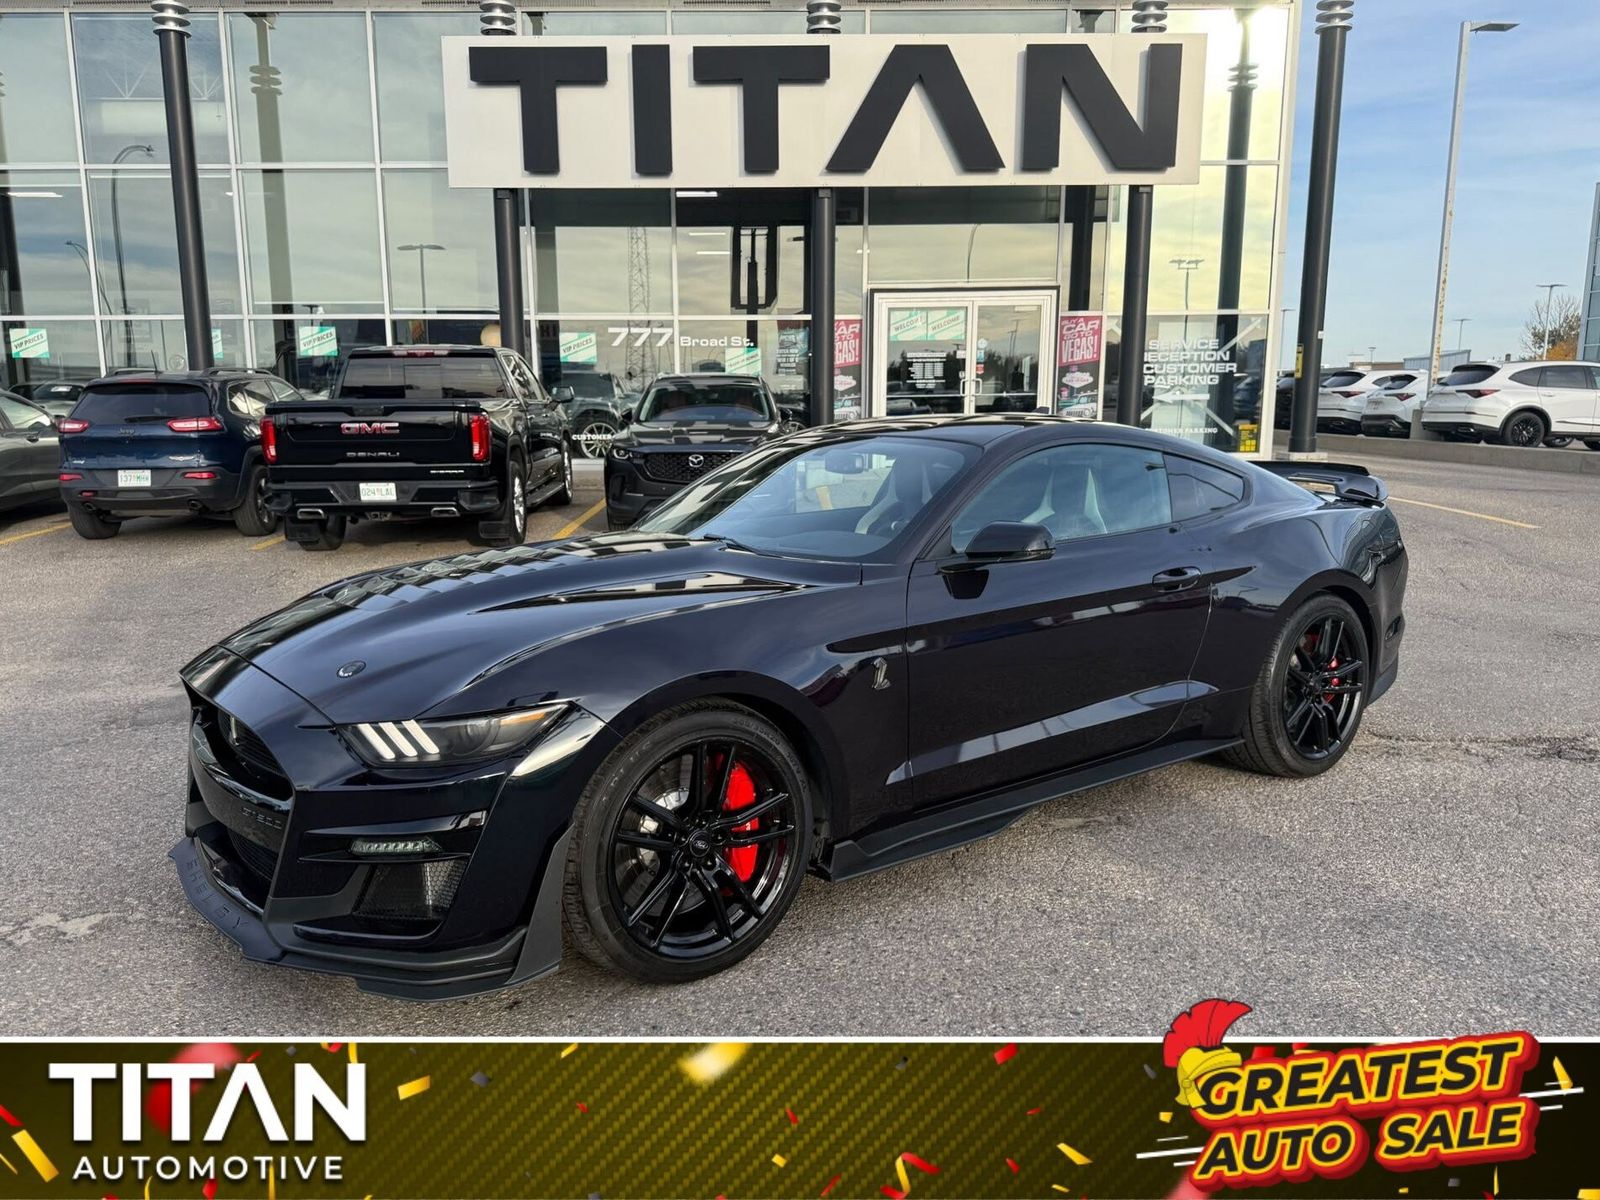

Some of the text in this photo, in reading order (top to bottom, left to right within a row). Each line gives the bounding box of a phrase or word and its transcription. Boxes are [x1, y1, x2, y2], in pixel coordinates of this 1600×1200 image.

[468, 43, 1183, 175] TITAN
[835, 323, 860, 336] AR
[931, 315, 960, 331] WELCOME
[1063, 320, 1099, 334] CAR
[14, 333, 44, 350] VIP PRICES
[312, 331, 333, 345] PRICES
[607, 327, 673, 347] 777
[680, 335, 755, 347] Broad St.
[562, 337, 593, 354] VIP PRICES
[835, 338, 860, 365] GAS!
[1062, 335, 1098, 363] VEGAS!
[1149, 339, 1219, 350] SERVICE
[1143, 362, 1237, 374] CUSTOMER
[1144, 374, 1219, 386] PARKING
[340, 421, 400, 435] GMC
[572, 433, 612, 441] CUSTOMER
